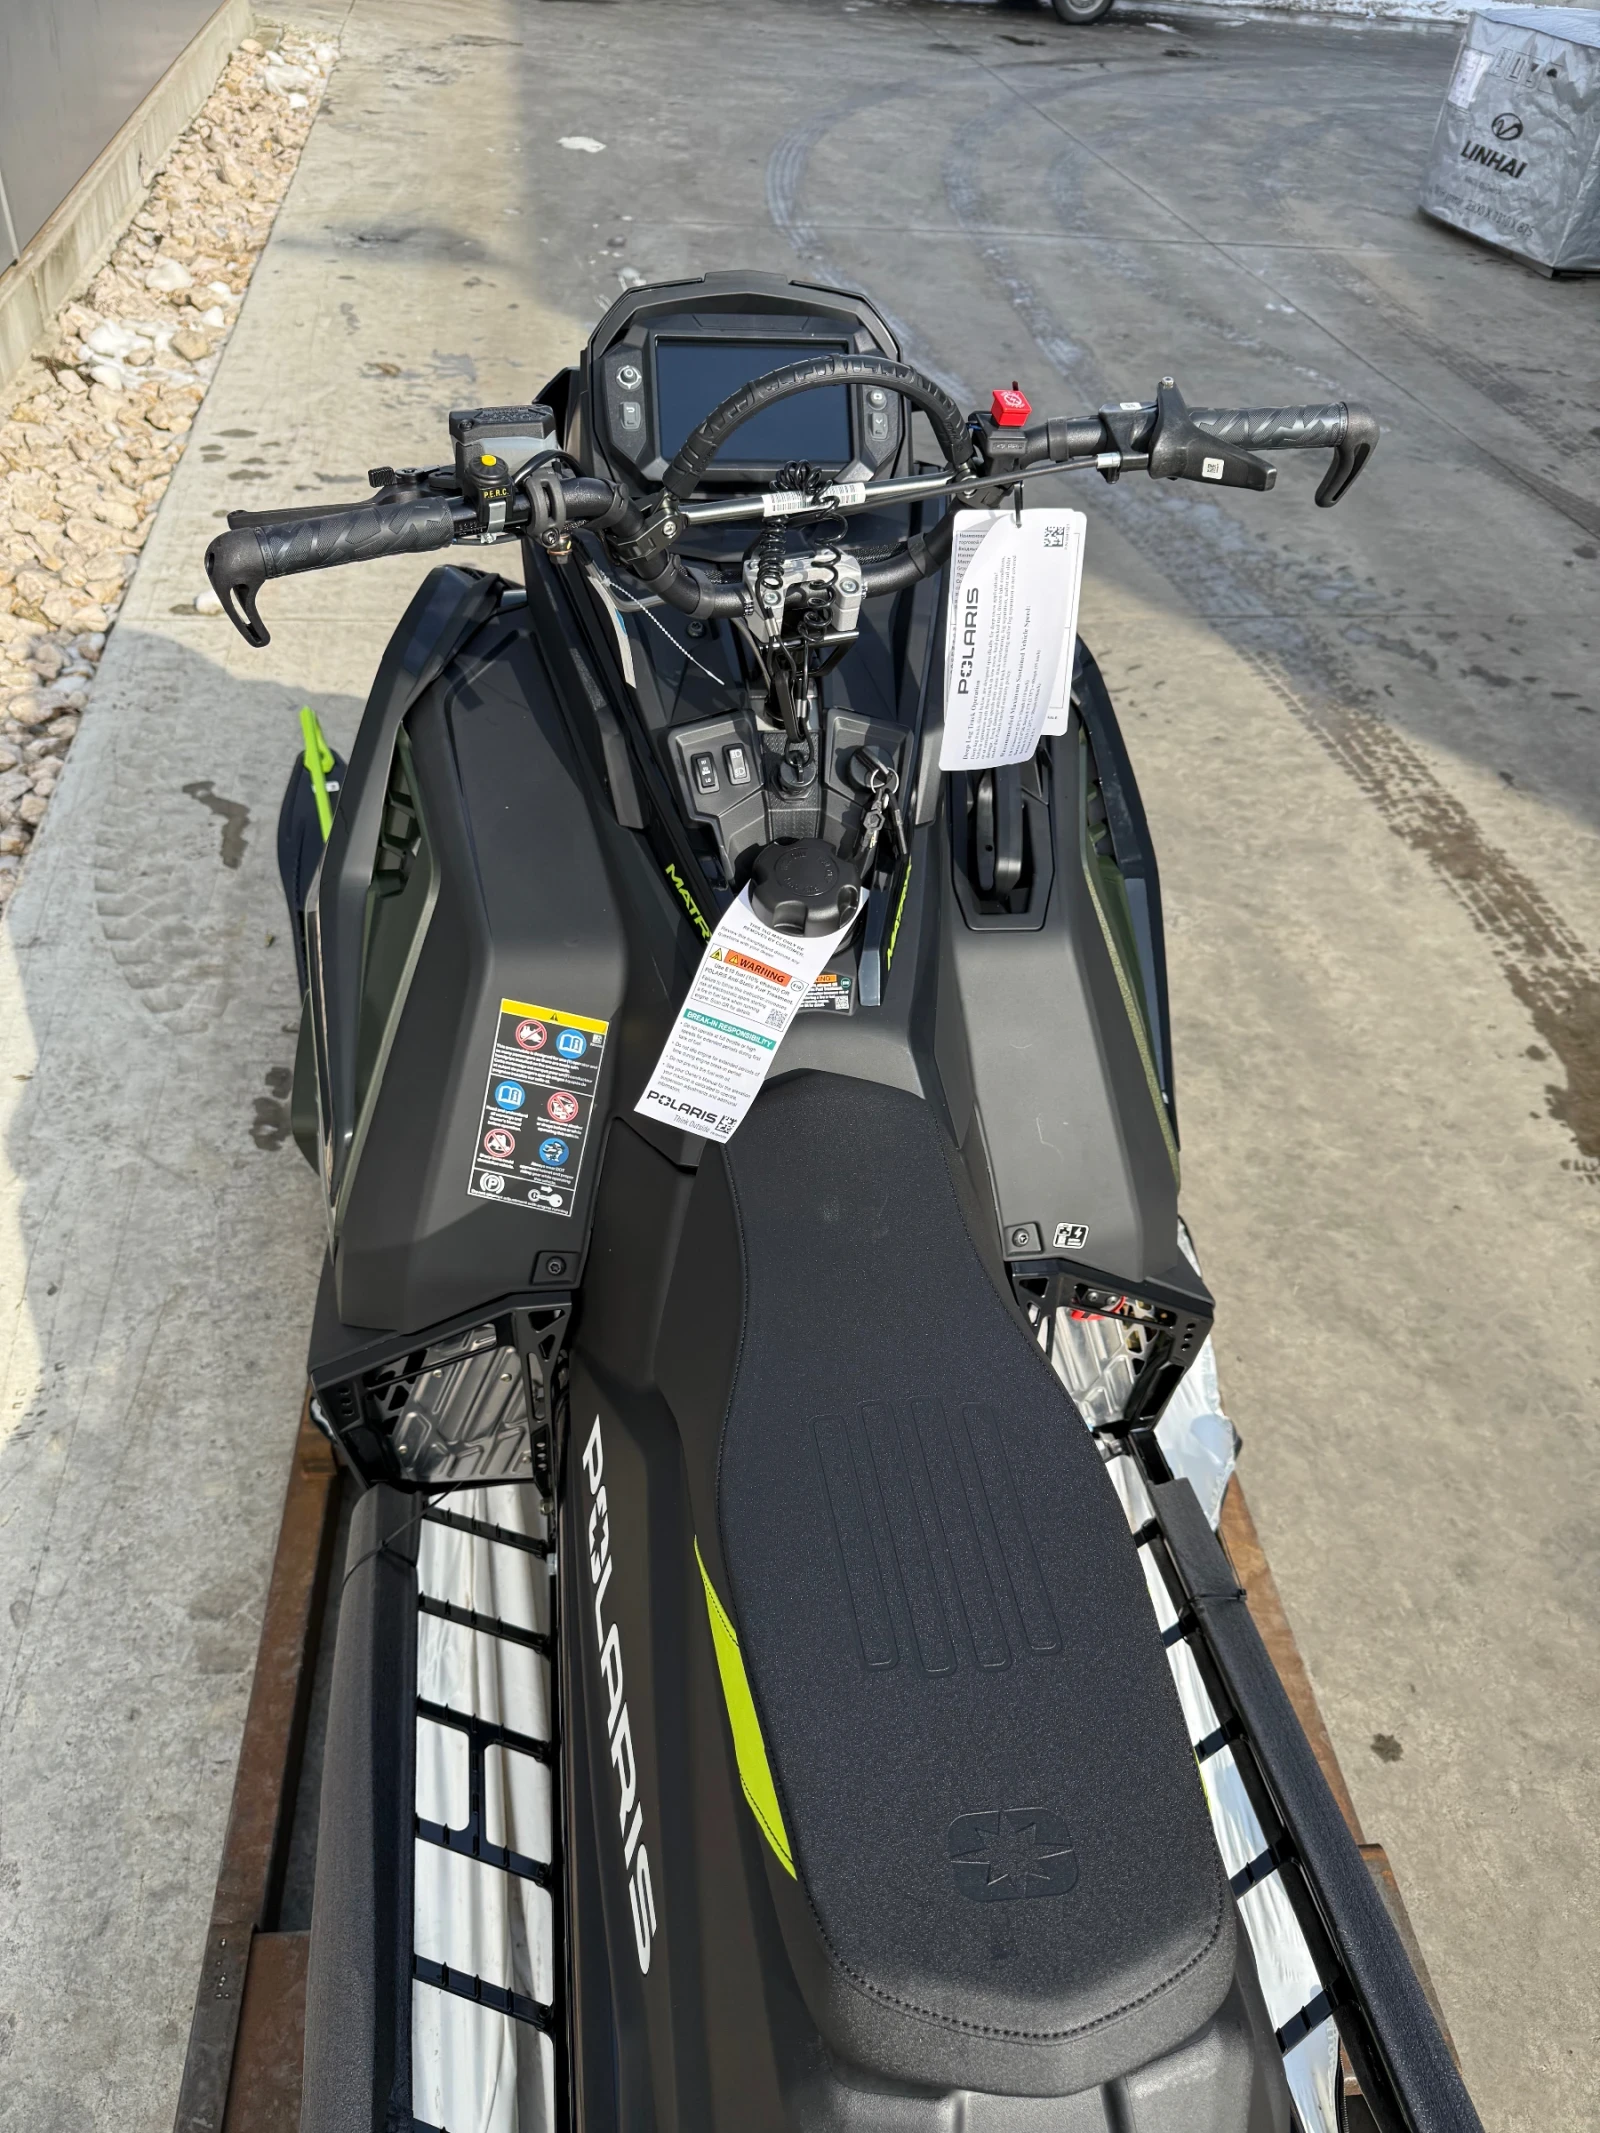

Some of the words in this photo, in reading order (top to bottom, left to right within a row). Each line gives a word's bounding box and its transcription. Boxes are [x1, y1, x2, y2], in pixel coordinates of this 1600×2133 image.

[1460, 140, 1528, 179] LINHAI
[484, 488, 510, 498] P.E.R.C.
[958, 588, 978, 694] POLARIS
[739, 958, 785, 982] WARNING
[686, 1011, 718, 1026] BREAK-IN
[717, 1023, 772, 1047] RESPONSIBILITY
[646, 1090, 718, 1124] POLARIS
[673, 1114, 689, 1125] Think
[688, 1120, 710, 1133] Outside
[582, 1414, 657, 1976] POLARIS
